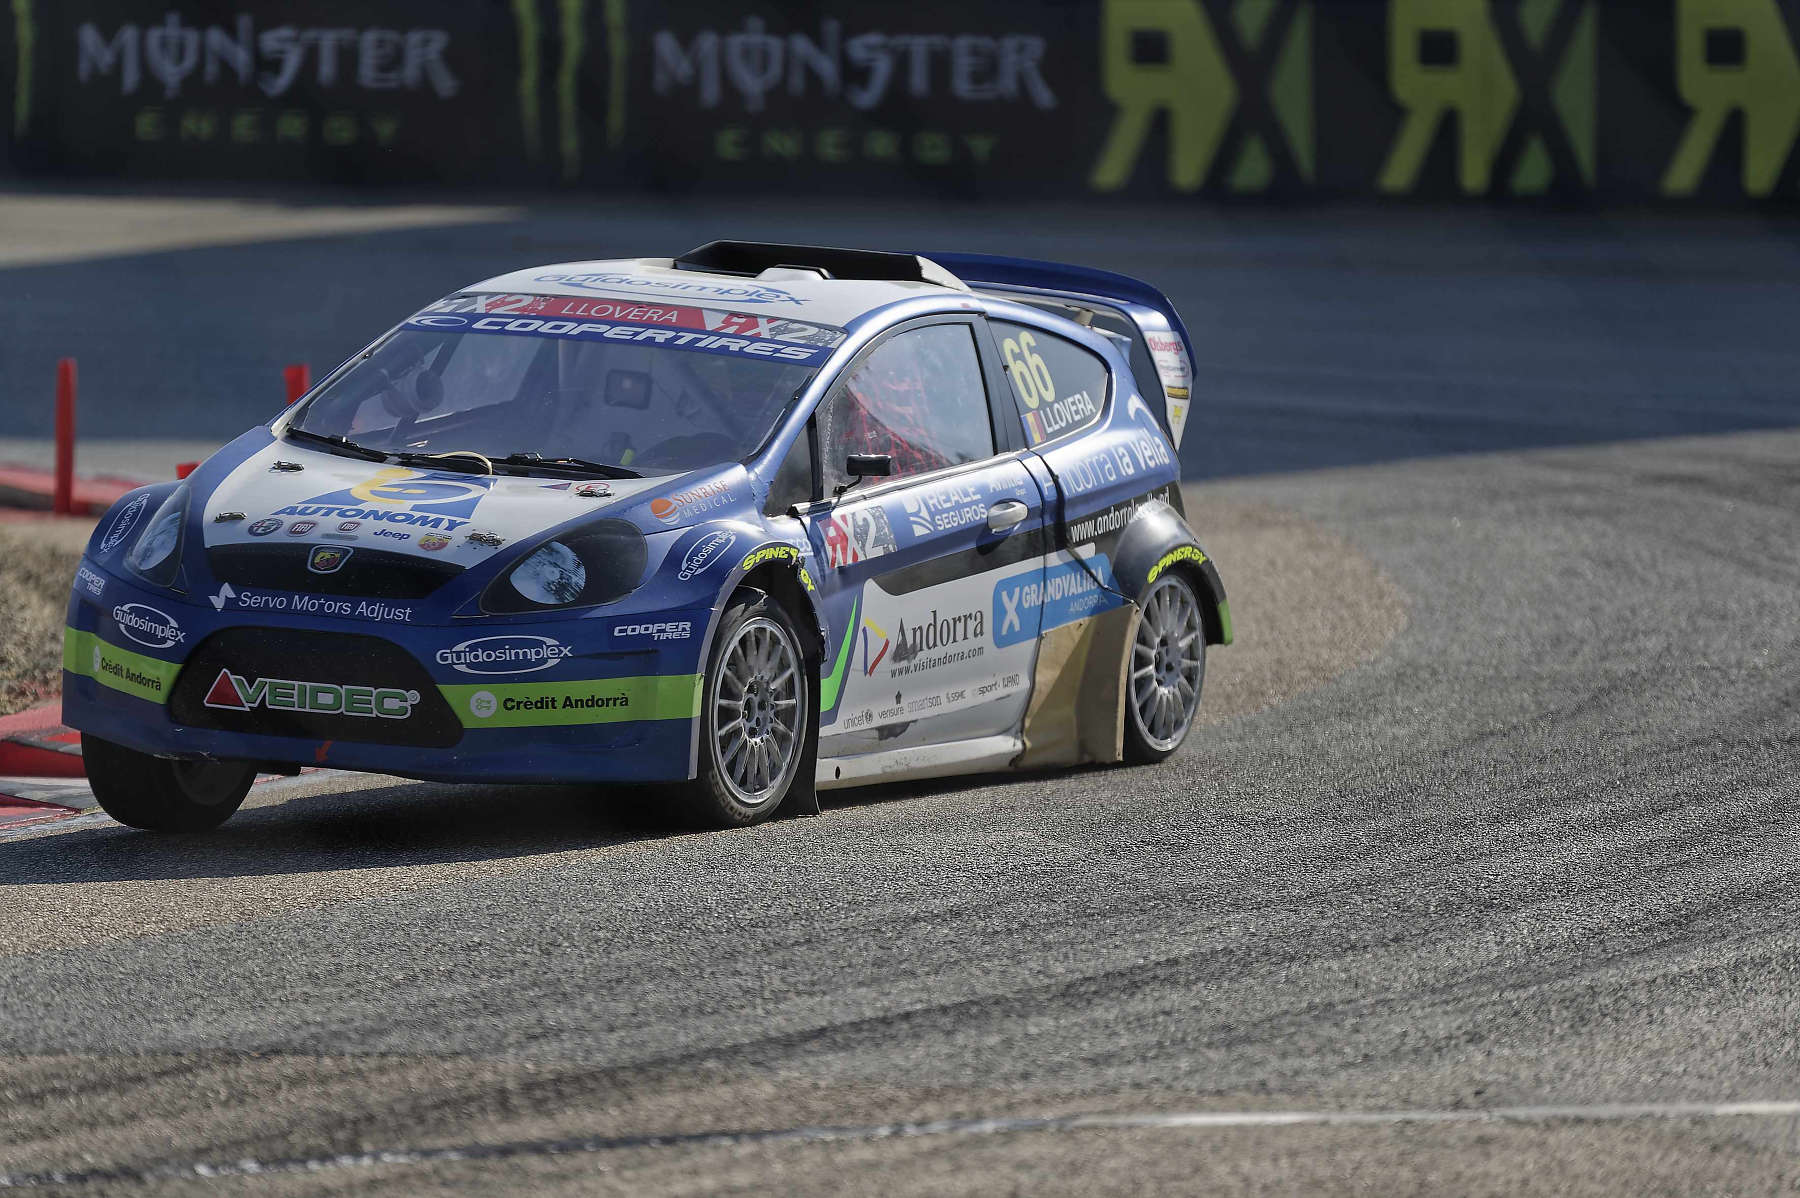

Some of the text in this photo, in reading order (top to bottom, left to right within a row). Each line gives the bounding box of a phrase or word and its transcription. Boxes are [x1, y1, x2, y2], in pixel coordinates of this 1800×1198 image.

[78, 12, 460, 98] MONSTER
[652, 15, 1057, 111] MONSTER
[135, 107, 397, 145] ENERGY
[715, 129, 996, 164] ENERGY
[559, 301, 679, 324] LLOVERA
[1003, 331, 1055, 409] 66
[1040, 391, 1096, 433] LLOVERA
[1111, 445, 1134, 476] la
[672, 480, 730, 507] SUNRISE
[684, 494, 736, 518] MEDICAL
[926, 485, 981, 511] REALE
[270, 506, 470, 531] AUTONOMY
[935, 503, 988, 530] SEGUROS
[373, 529, 411, 540] Jeep
[80, 567, 105, 589] COOPER
[238, 592, 288, 609] Servo
[357, 601, 412, 623] Adjust
[113, 605, 186, 643] Guidosimplex
[614, 622, 691, 636] COOPER
[652, 631, 691, 640] TIRES
[892, 609, 984, 663] Andorra
[436, 643, 573, 665] Guidosimplex
[891, 646, 984, 678] www.visitandorra.com
[231, 676, 412, 720] VEIDEC
[503, 692, 629, 711] Crèdit Andorrà
[843, 710, 865, 729] unicef
